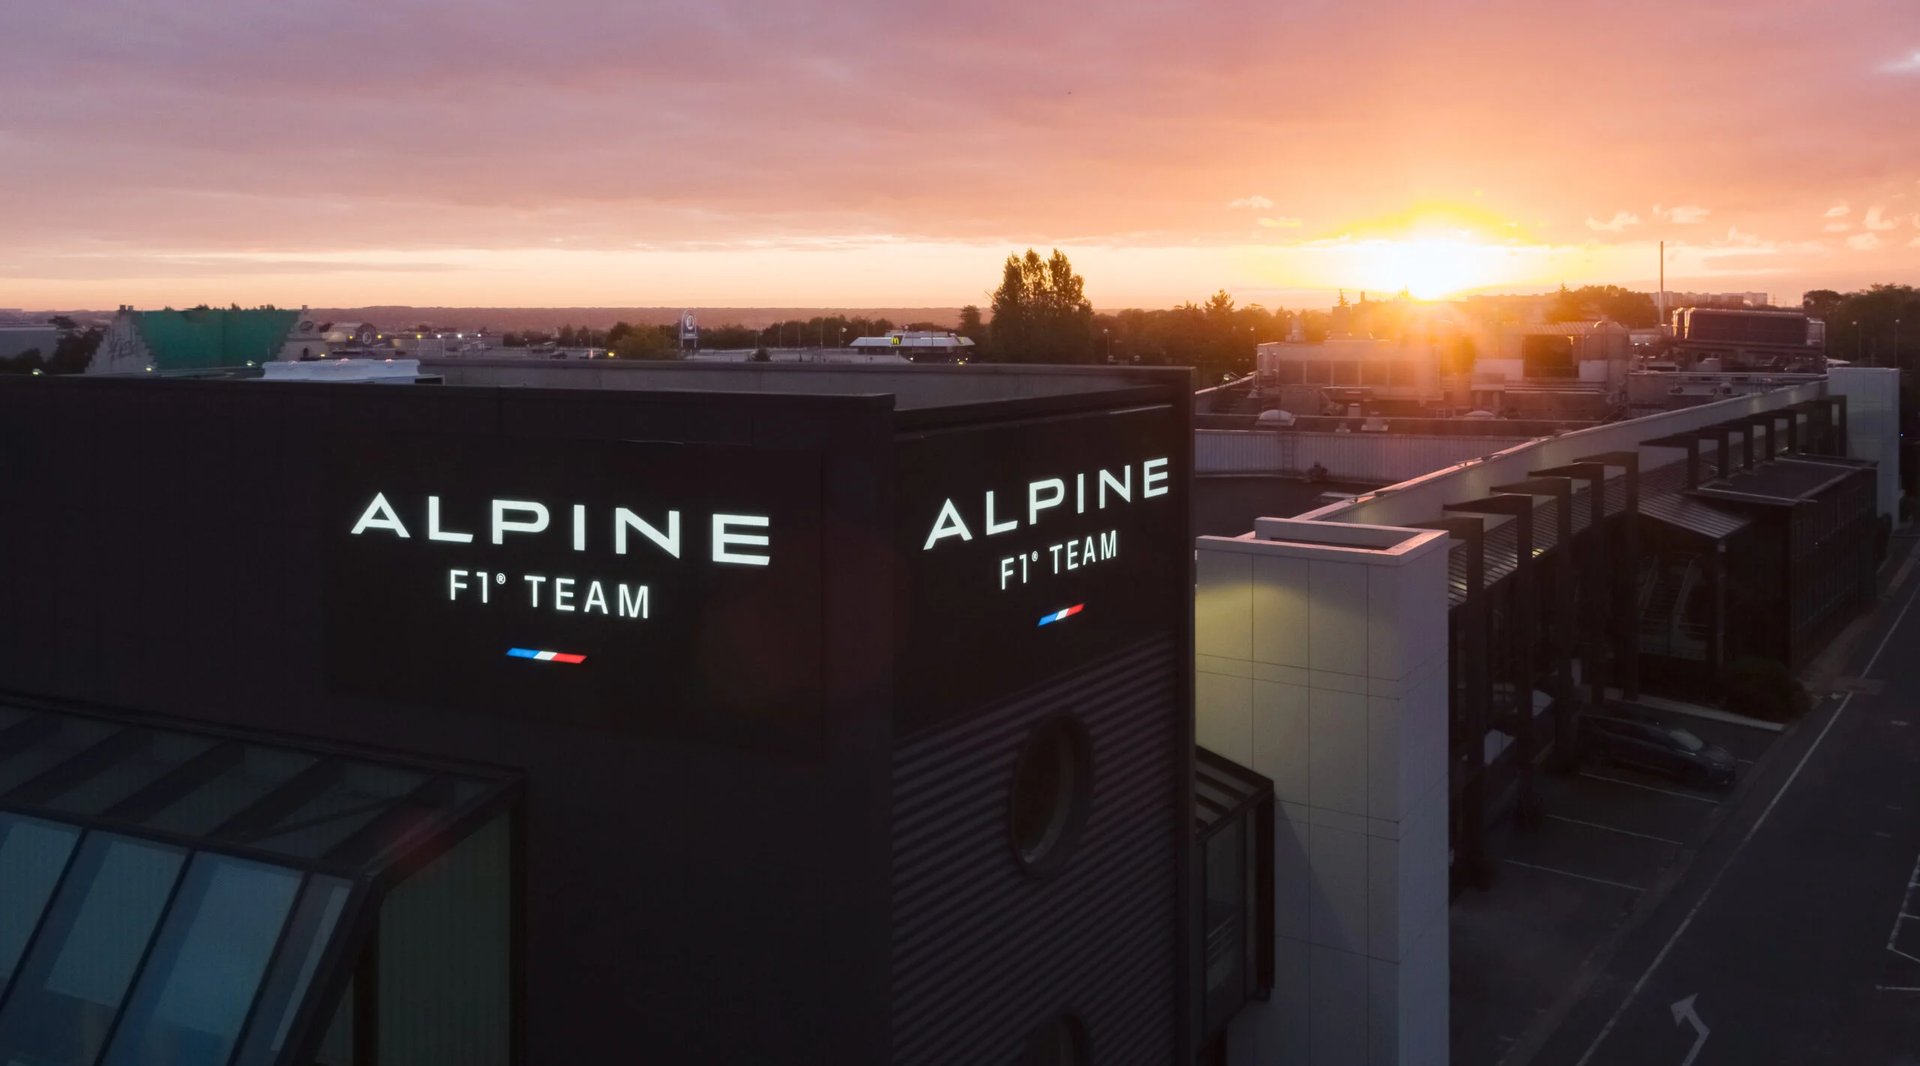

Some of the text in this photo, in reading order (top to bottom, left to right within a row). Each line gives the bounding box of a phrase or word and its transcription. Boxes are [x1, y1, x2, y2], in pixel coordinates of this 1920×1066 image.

[350, 491, 771, 566] ALPINE
[923, 457, 1170, 551] ALPINE
[1048, 529, 1117, 575] TEAM
[523, 574, 649, 619] TEAM
